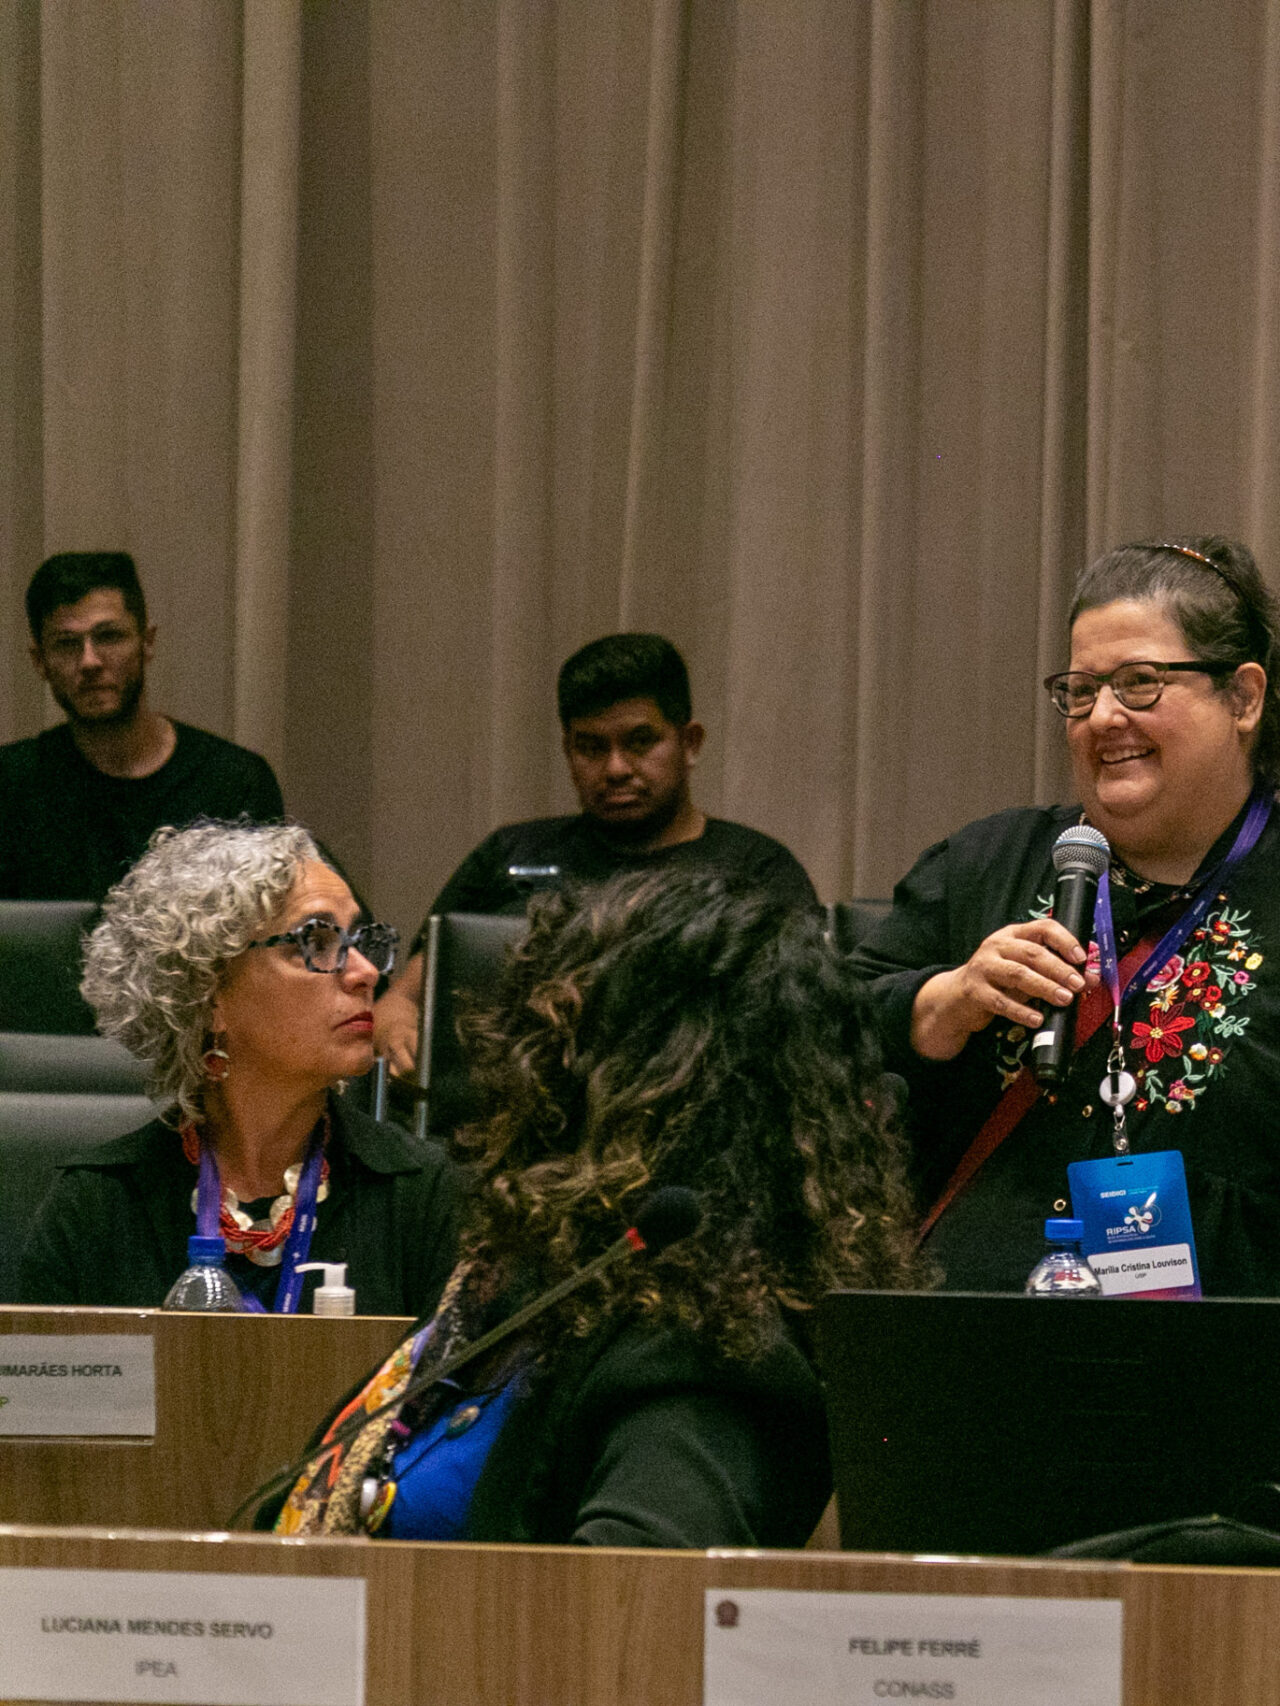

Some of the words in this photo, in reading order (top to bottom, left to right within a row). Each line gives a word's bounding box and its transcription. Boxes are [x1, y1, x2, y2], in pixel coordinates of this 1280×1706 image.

[1105, 1225, 1137, 1236] RIPSA
[1121, 1262, 1150, 1273] Cristina
[1152, 1257, 1188, 1269] Louvison
[72, 1364, 123, 1377] HORTA
[41, 1617, 121, 1634] LUCIANA
[127, 1619, 205, 1636] MENDES
[208, 1621, 274, 1640] SERVO
[849, 1638, 913, 1656] FELIPE
[873, 1679, 955, 1699] CONASS
